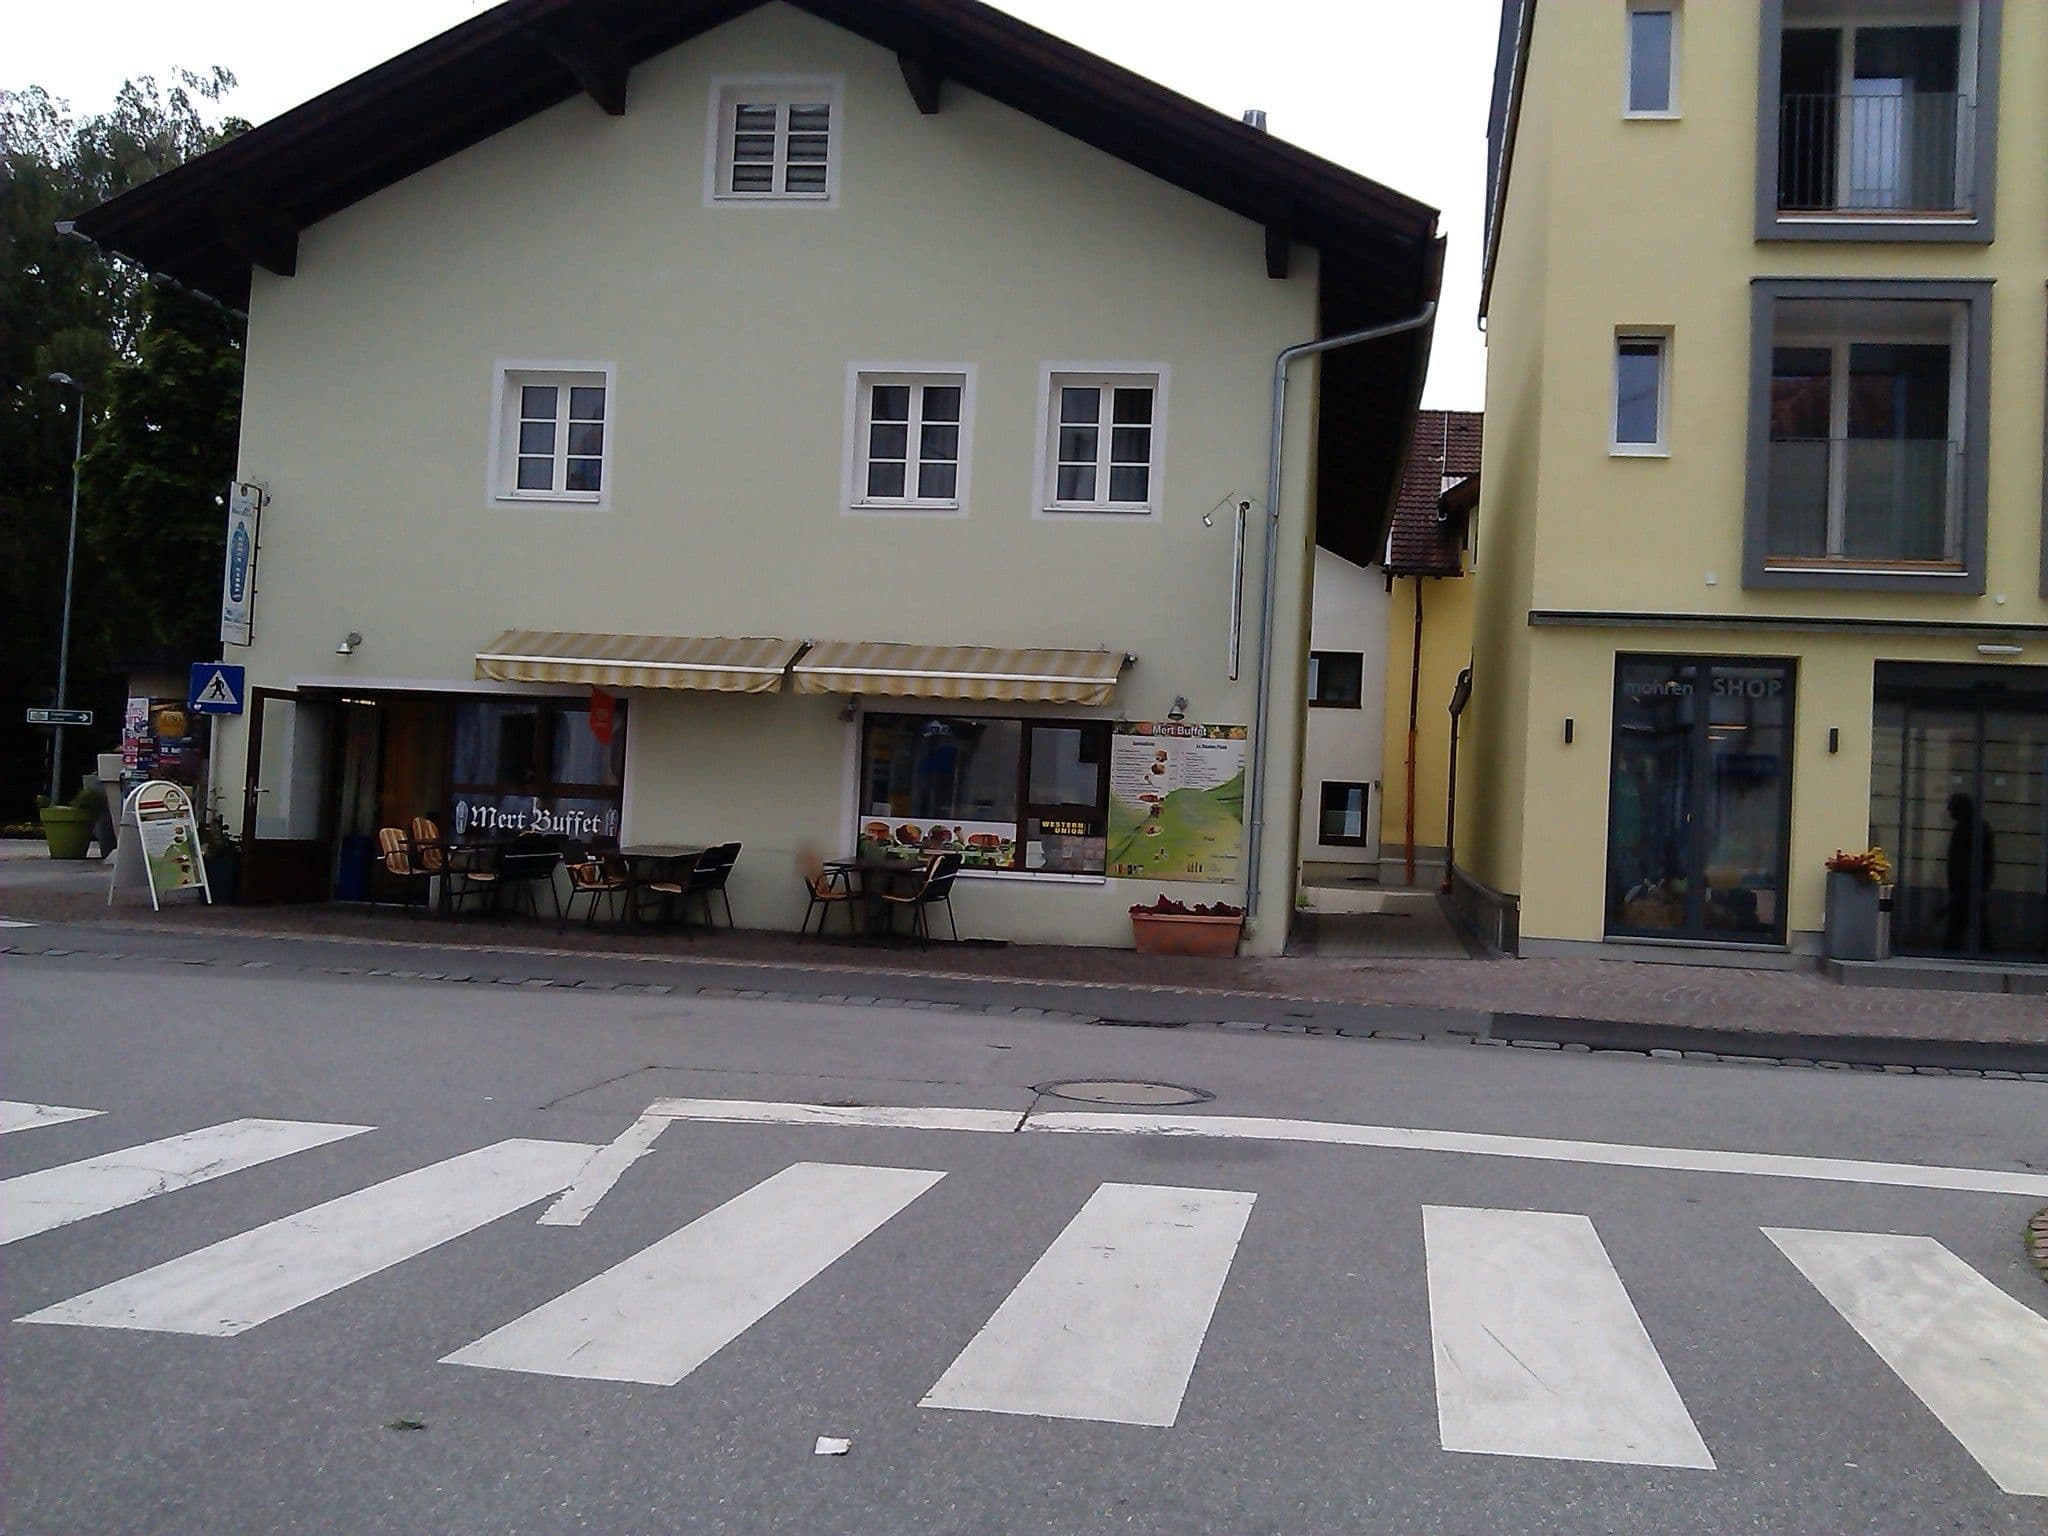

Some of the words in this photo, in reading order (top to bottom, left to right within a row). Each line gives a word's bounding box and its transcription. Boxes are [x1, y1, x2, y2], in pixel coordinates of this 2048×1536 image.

[1623, 680, 1694, 696] mohren
[1711, 678, 1782, 697] SHOP
[1152, 724, 1175, 736] Mert
[1177, 725, 1207, 737] Buffet
[470, 805, 527, 830] Mert
[529, 796, 601, 837] Buffet
[1041, 820, 1084, 829] WESTERN
[1054, 827, 1084, 835] UNION
